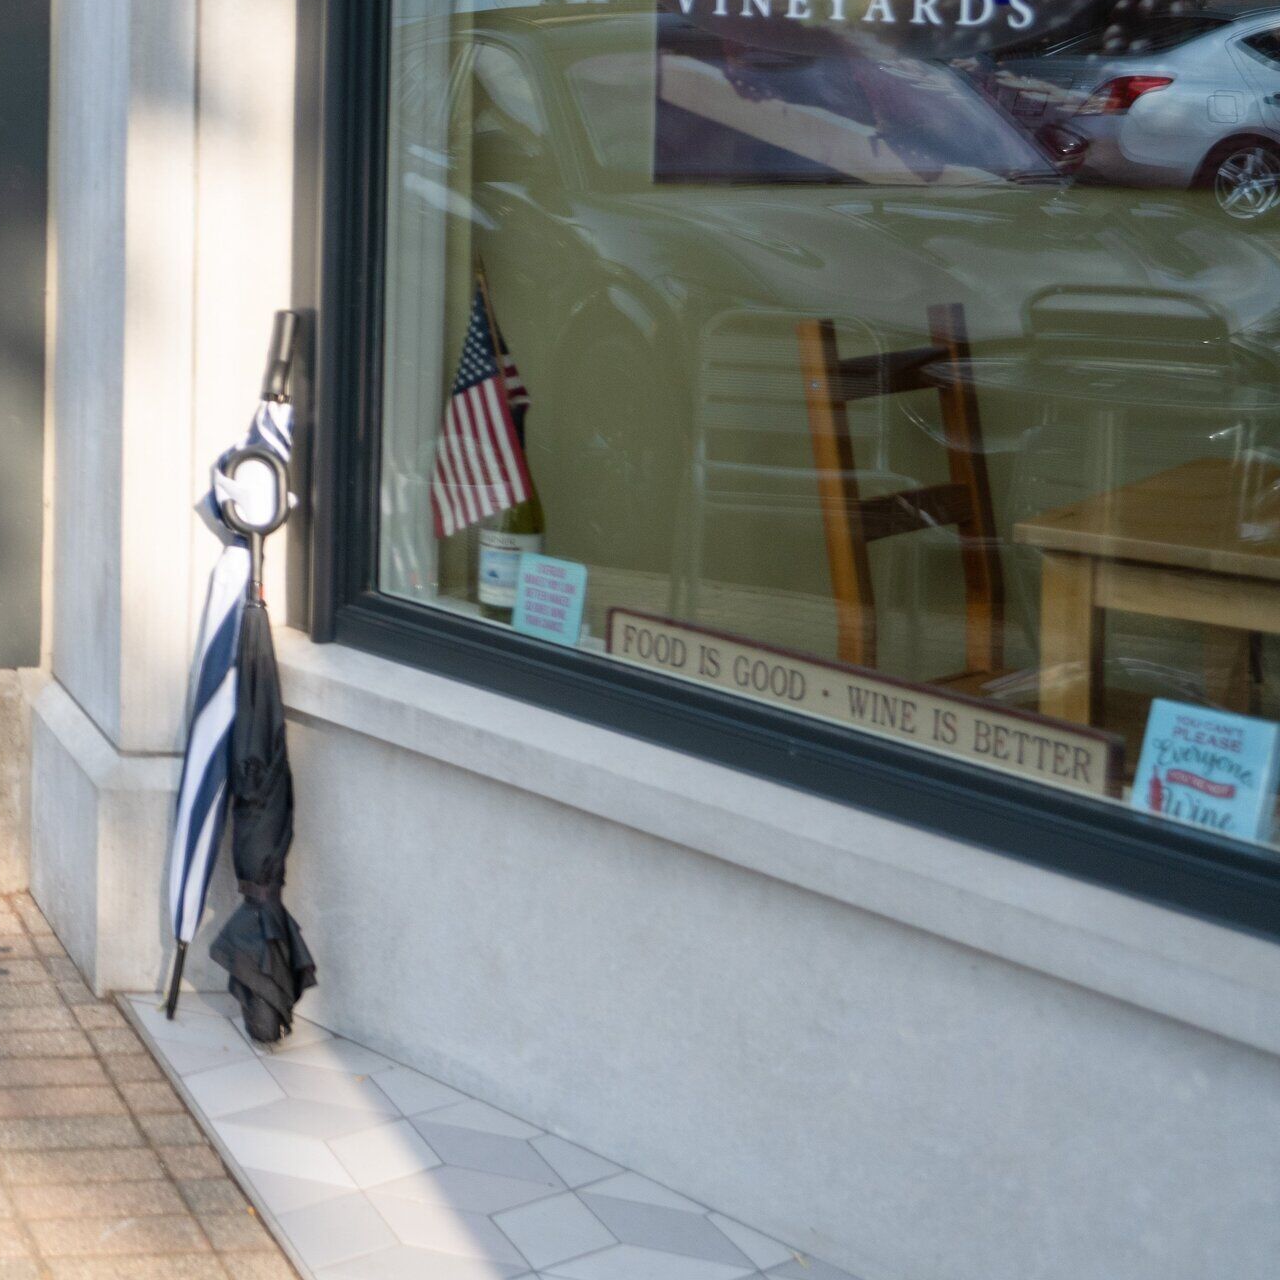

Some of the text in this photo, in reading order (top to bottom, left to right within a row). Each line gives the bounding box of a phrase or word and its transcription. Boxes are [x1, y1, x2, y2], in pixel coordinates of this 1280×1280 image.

[622, 623, 1095, 785] FOOD IS GOOD WINE IS BETTER
